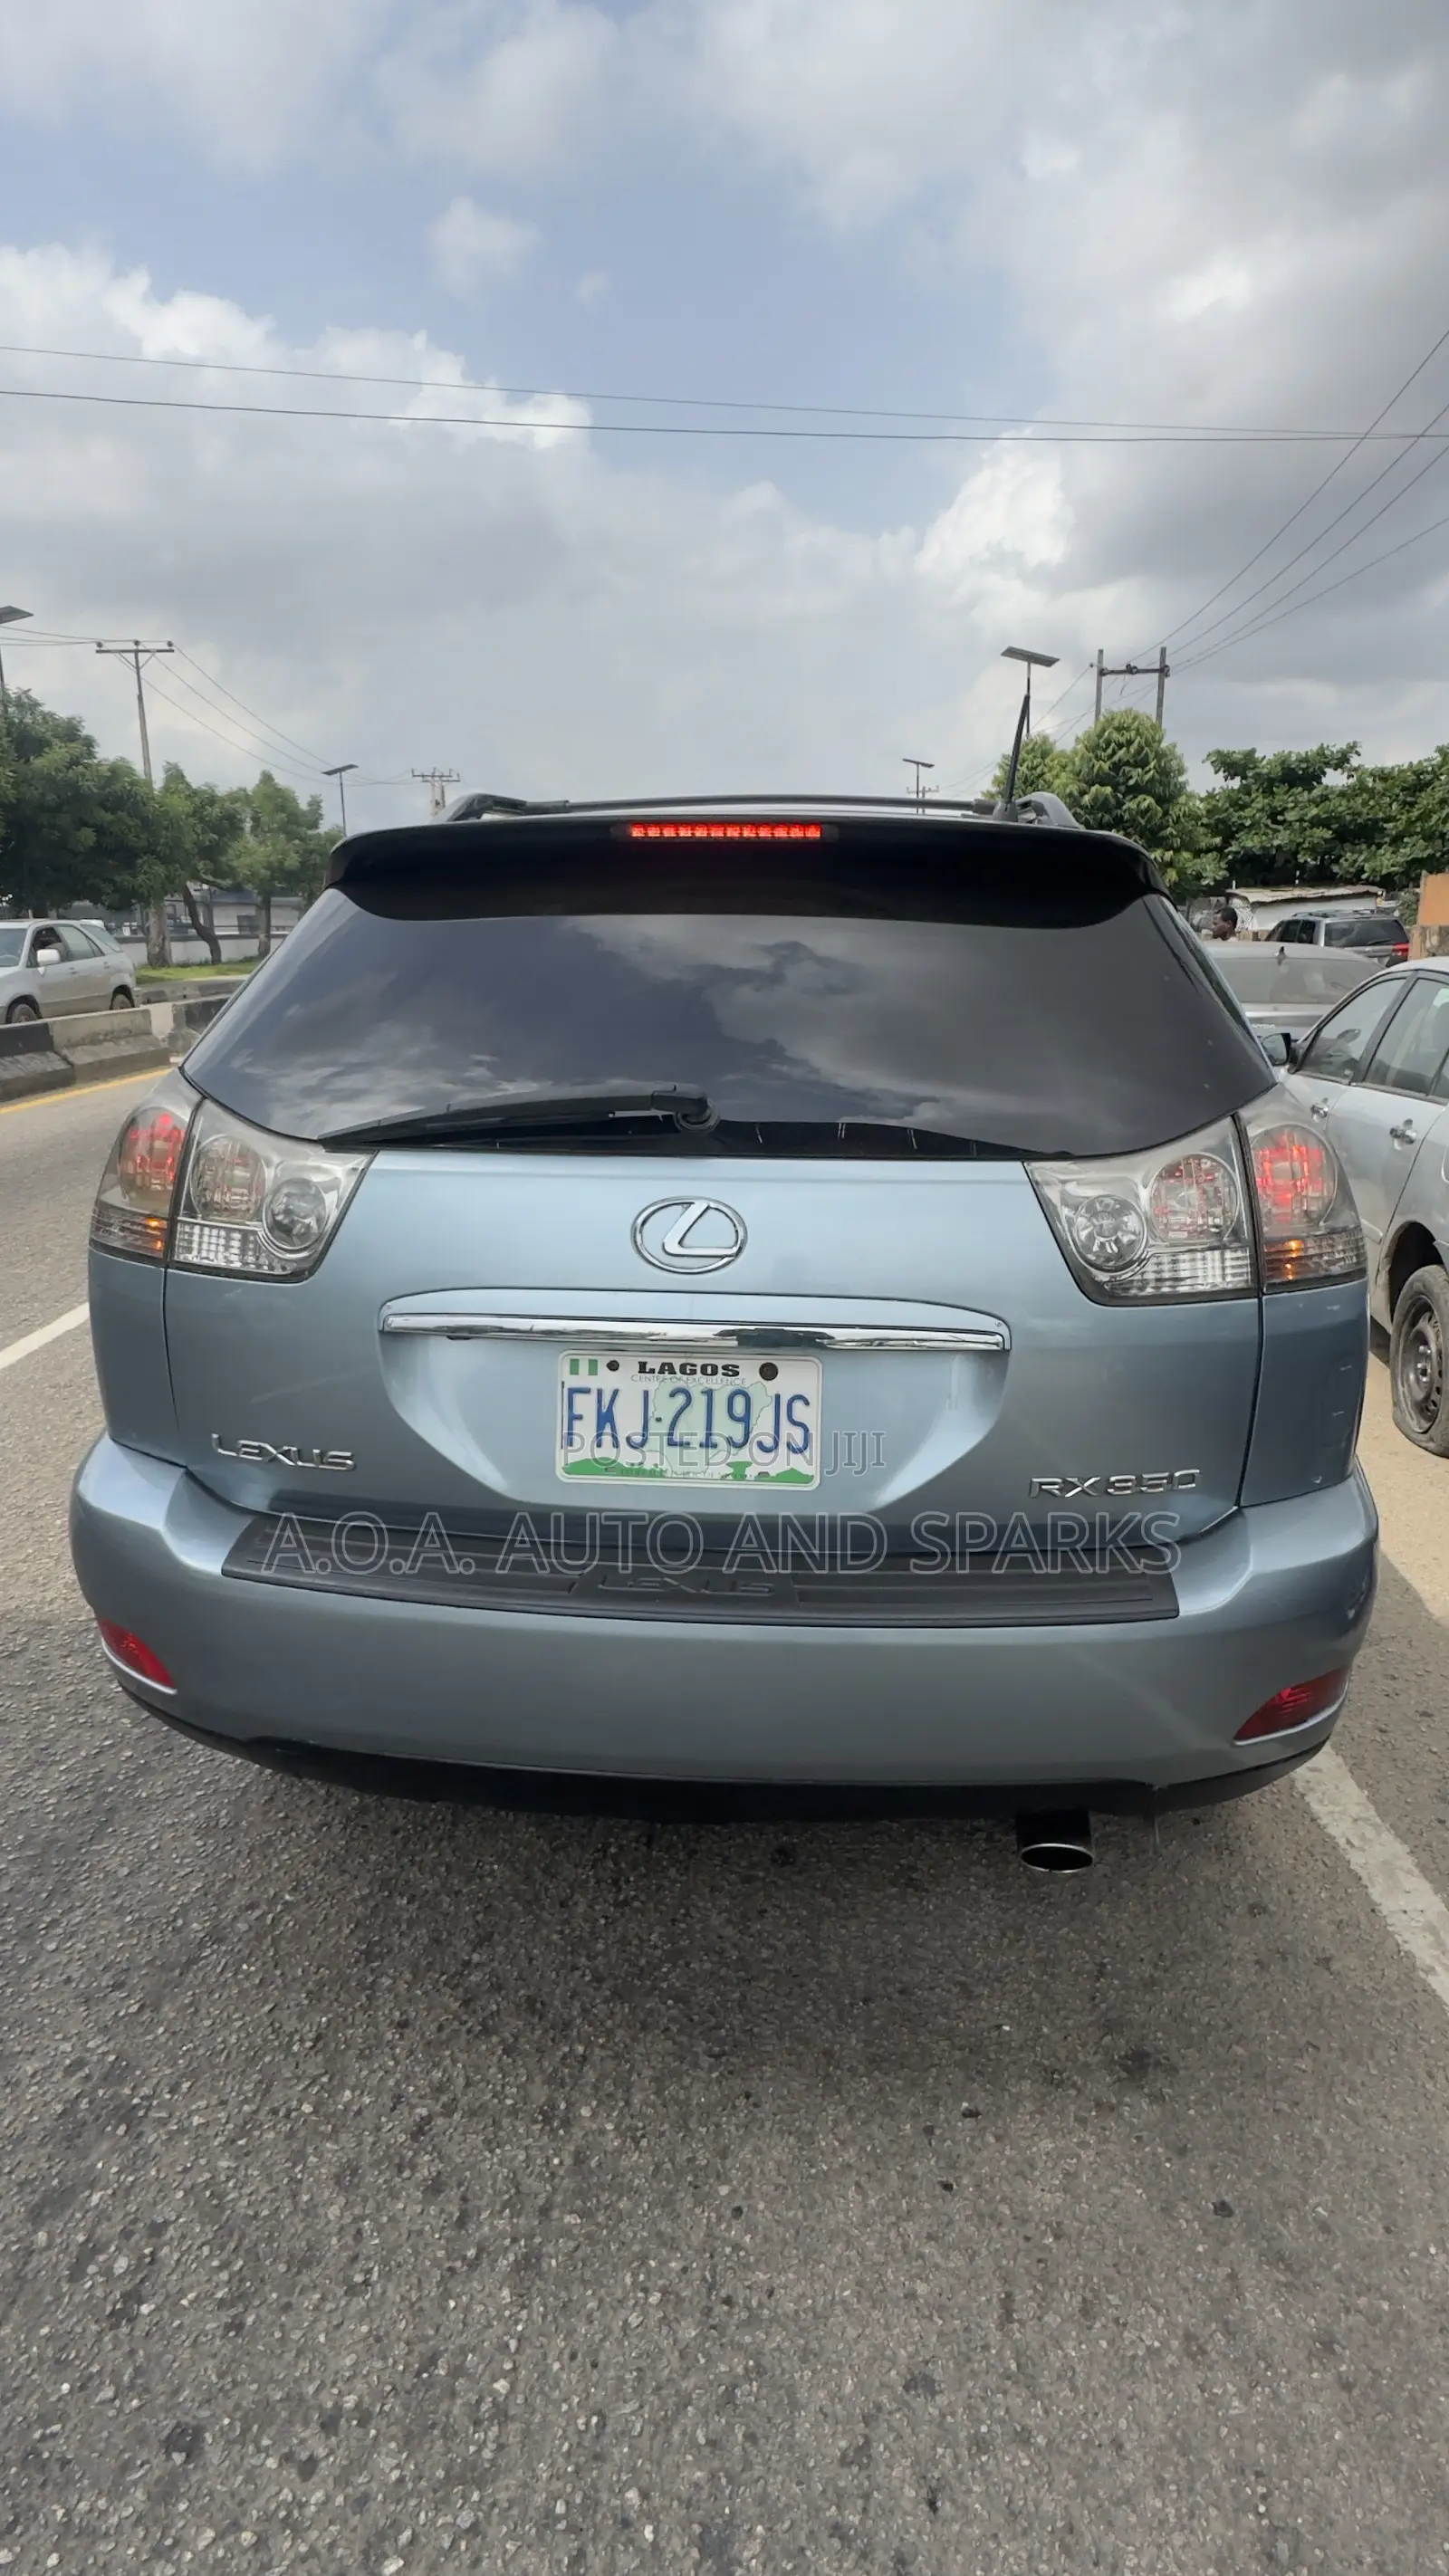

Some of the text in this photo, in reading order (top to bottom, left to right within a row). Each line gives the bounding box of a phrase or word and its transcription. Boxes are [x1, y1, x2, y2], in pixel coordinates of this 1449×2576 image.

[638, 1361, 741, 1377] LAGOS
[211, 1432, 356, 1471] LEXUS
[1029, 1469, 1201, 1499] RX 350
